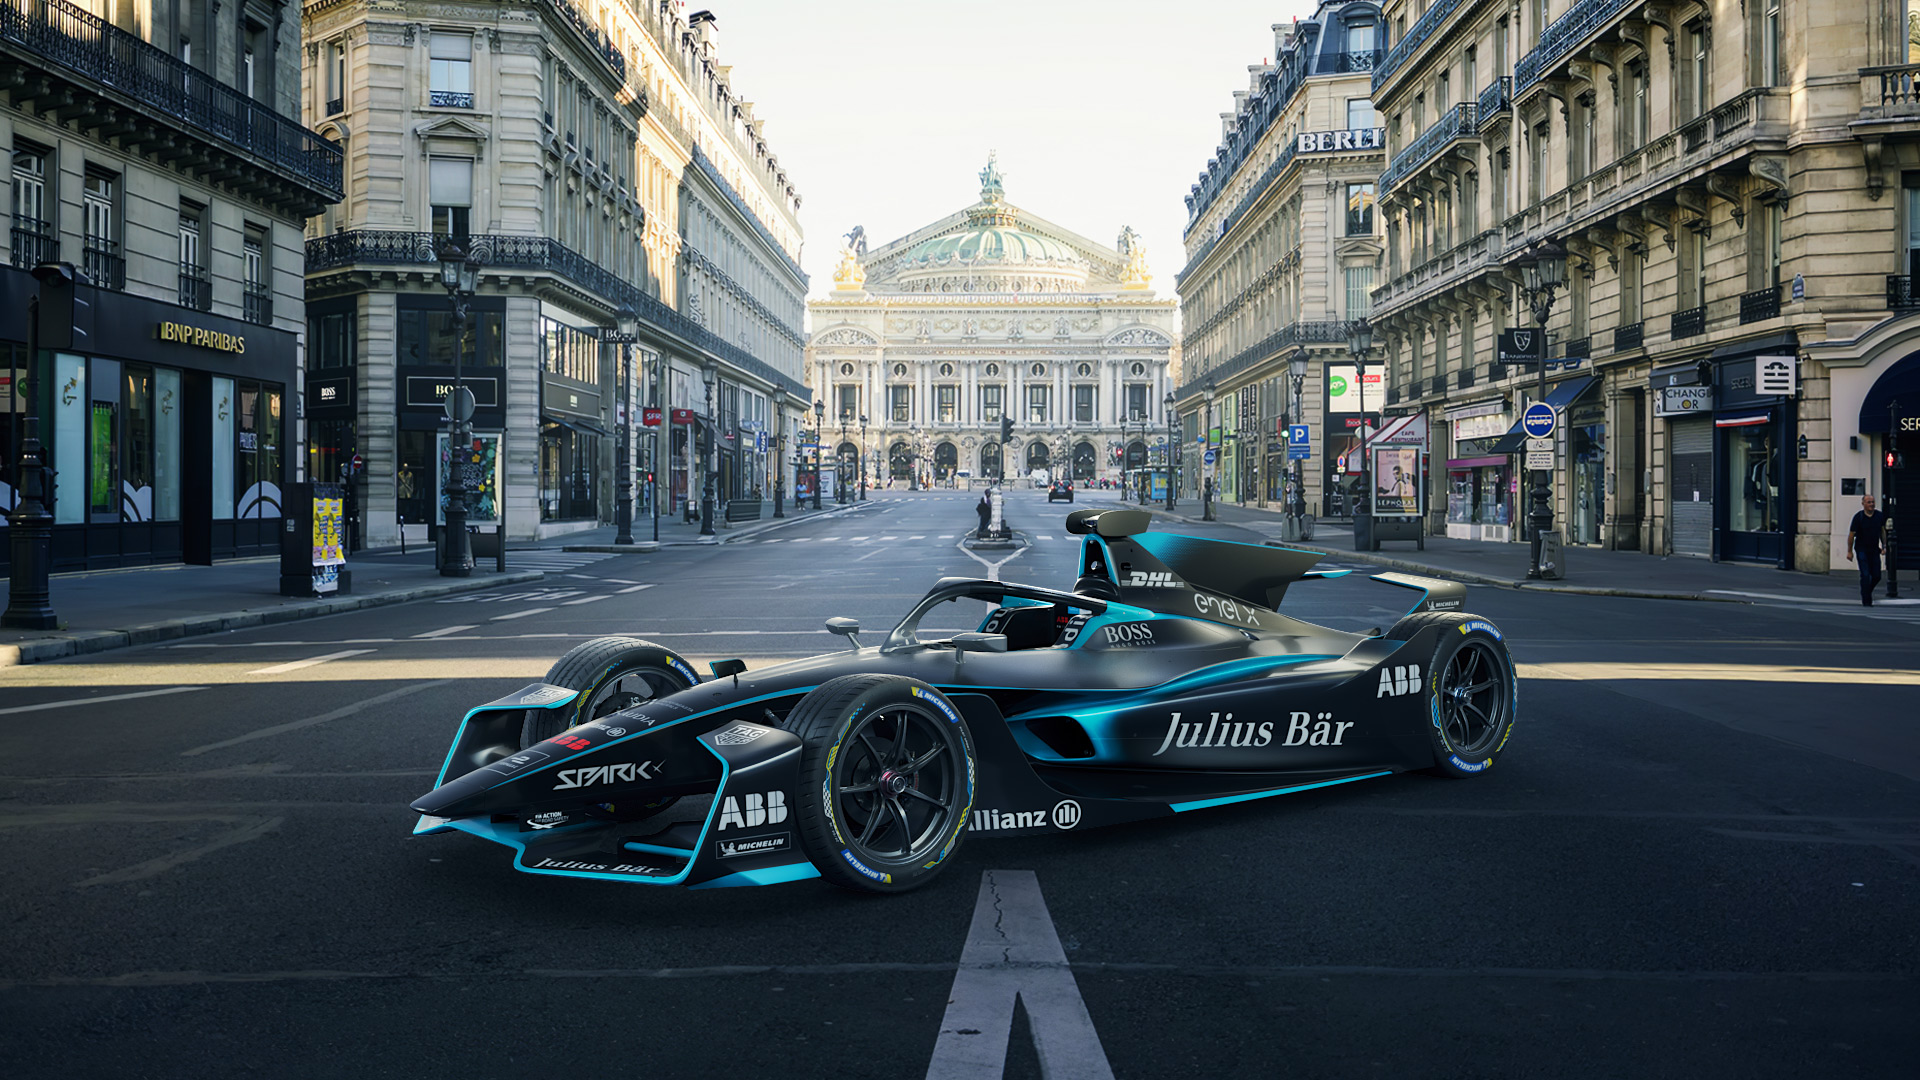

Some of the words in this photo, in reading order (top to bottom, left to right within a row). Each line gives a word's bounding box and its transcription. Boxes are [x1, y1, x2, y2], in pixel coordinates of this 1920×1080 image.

[1298, 128, 1385, 152] BERLI
[162, 321, 193, 344] BNP
[193, 327, 245, 354] PARIBAS
[1295, 428, 1305, 442] P
[1129, 571, 1177, 588] DHL
[1193, 593, 1242, 622] enel
[1435, 600, 1460, 608] MICHELIN
[1104, 622, 1154, 645] BOSS
[1471, 621, 1501, 640] MICHELIN
[676, 663, 698, 685] MICHEL
[1376, 663, 1423, 699] ABB
[924, 692, 957, 721] MICHELIN
[548, 734, 591, 751] ABB
[733, 725, 766, 739] TAG
[1152, 711, 1275, 756] Julius
[1282, 711, 1355, 747] Bär
[1451, 756, 1484, 772] MICHELIN
[552, 760, 654, 791] SPARK
[543, 811, 563, 819] ACTION
[717, 789, 789, 832] ABB
[737, 837, 785, 852] MICHELIN
[532, 857, 608, 871] Julius
[610, 863, 662, 874] Bär
[844, 851, 880, 880] MICHELIN
